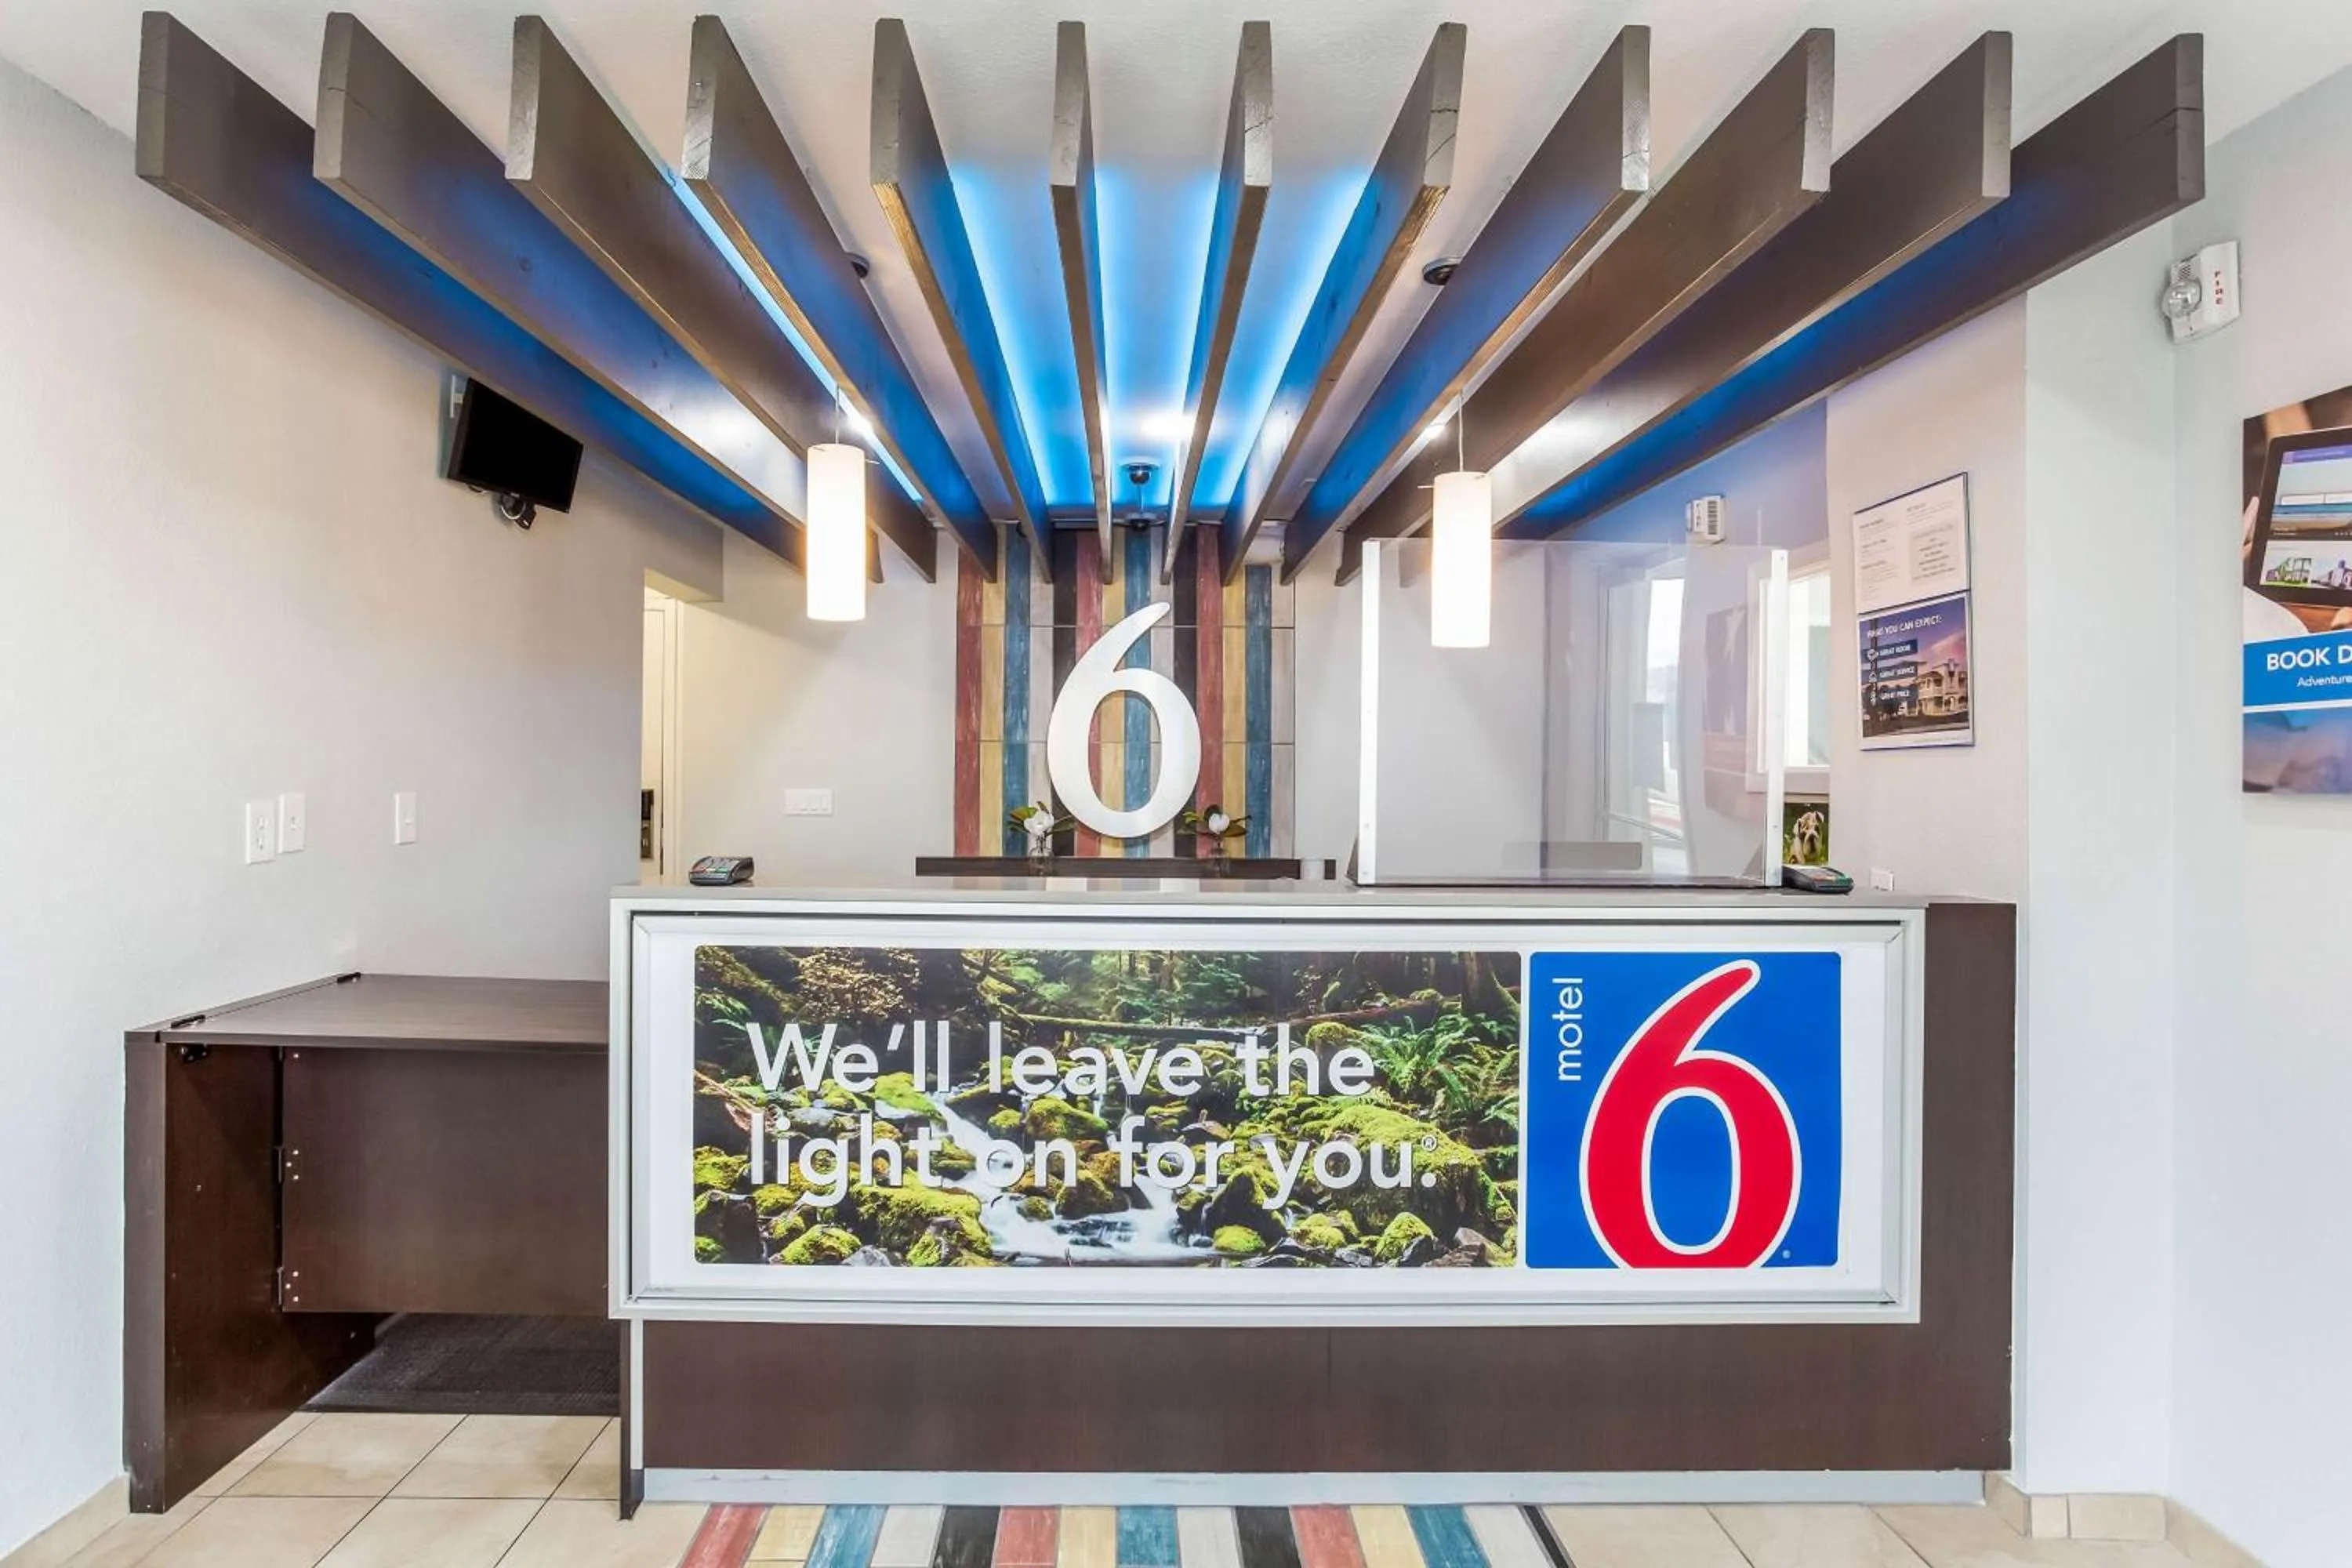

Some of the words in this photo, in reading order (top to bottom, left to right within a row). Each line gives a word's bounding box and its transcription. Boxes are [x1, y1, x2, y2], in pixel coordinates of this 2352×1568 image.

[2267, 647, 2331, 671] BOOK
[1047, 601, 1202, 838] 6
[746, 1020, 949, 1092] We'll
[989, 1021, 1205, 1095] leave
[1236, 1022, 1374, 1097] the
[1552, 978, 1582, 1081] motel
[750, 1113, 946, 1208] light
[975, 1138, 1077, 1188] on
[1108, 1115, 1236, 1189] for
[1579, 959, 1802, 1269] 6
